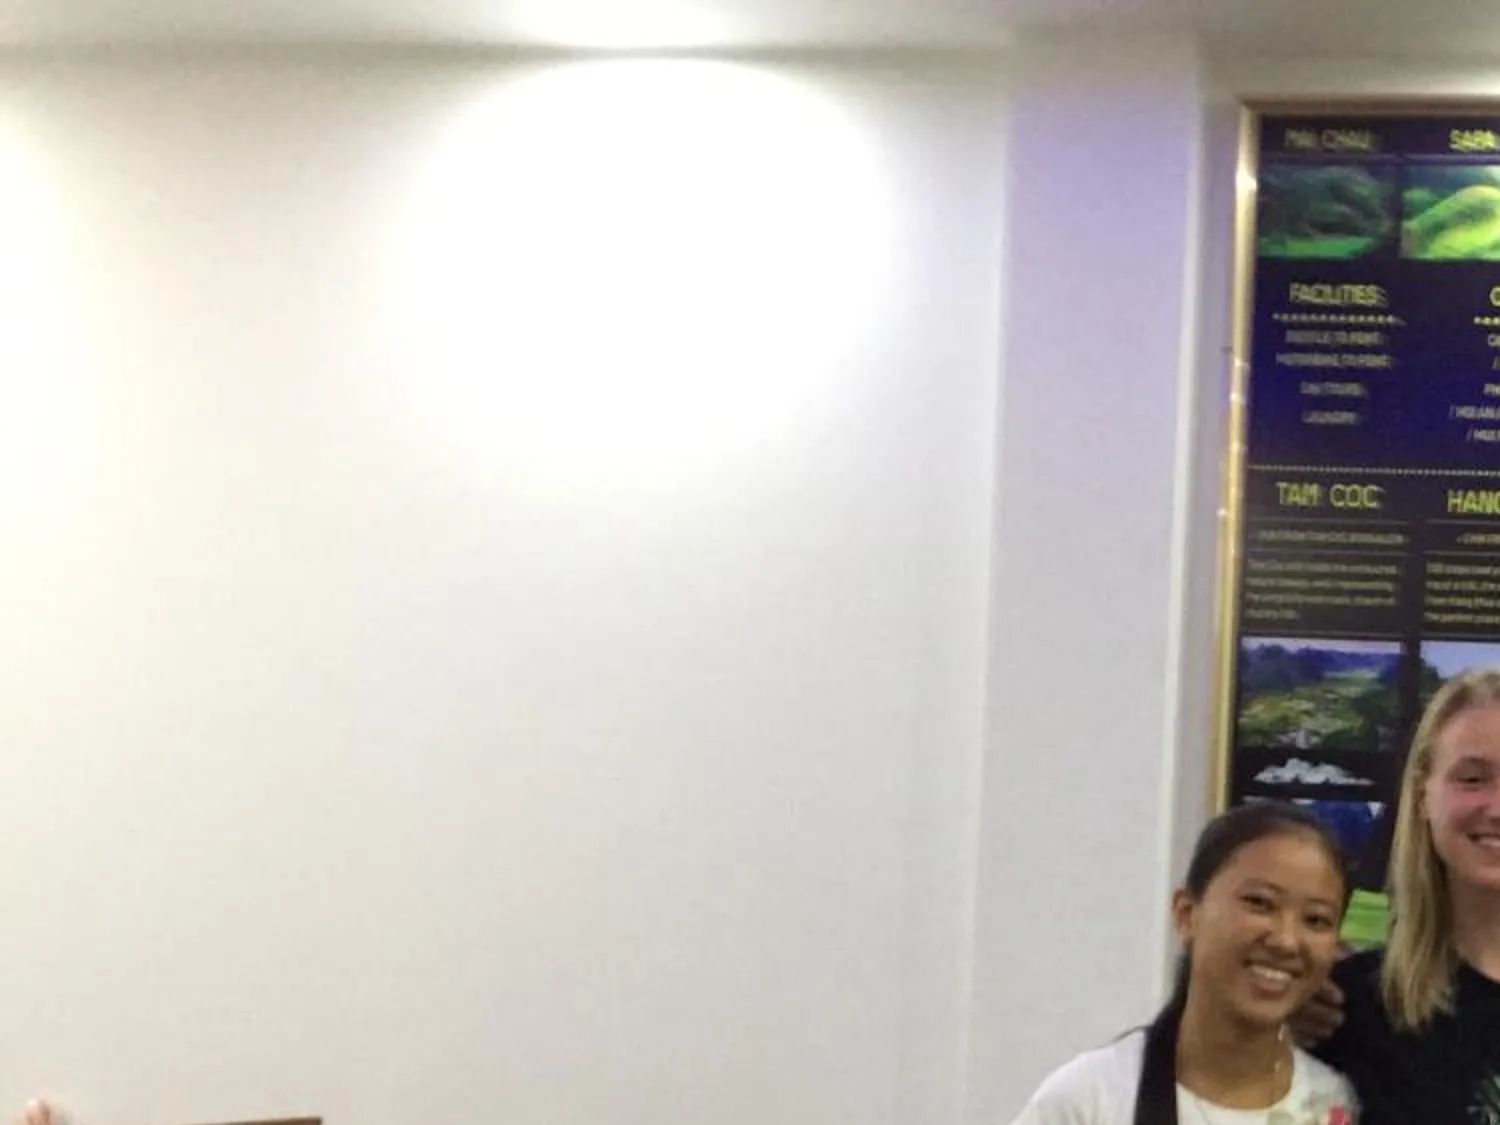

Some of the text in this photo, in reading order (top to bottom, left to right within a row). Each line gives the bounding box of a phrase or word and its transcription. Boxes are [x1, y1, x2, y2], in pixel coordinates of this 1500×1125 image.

[1290, 283, 1386, 306] FACILITIES
[1277, 482, 1385, 508] TAM COC
